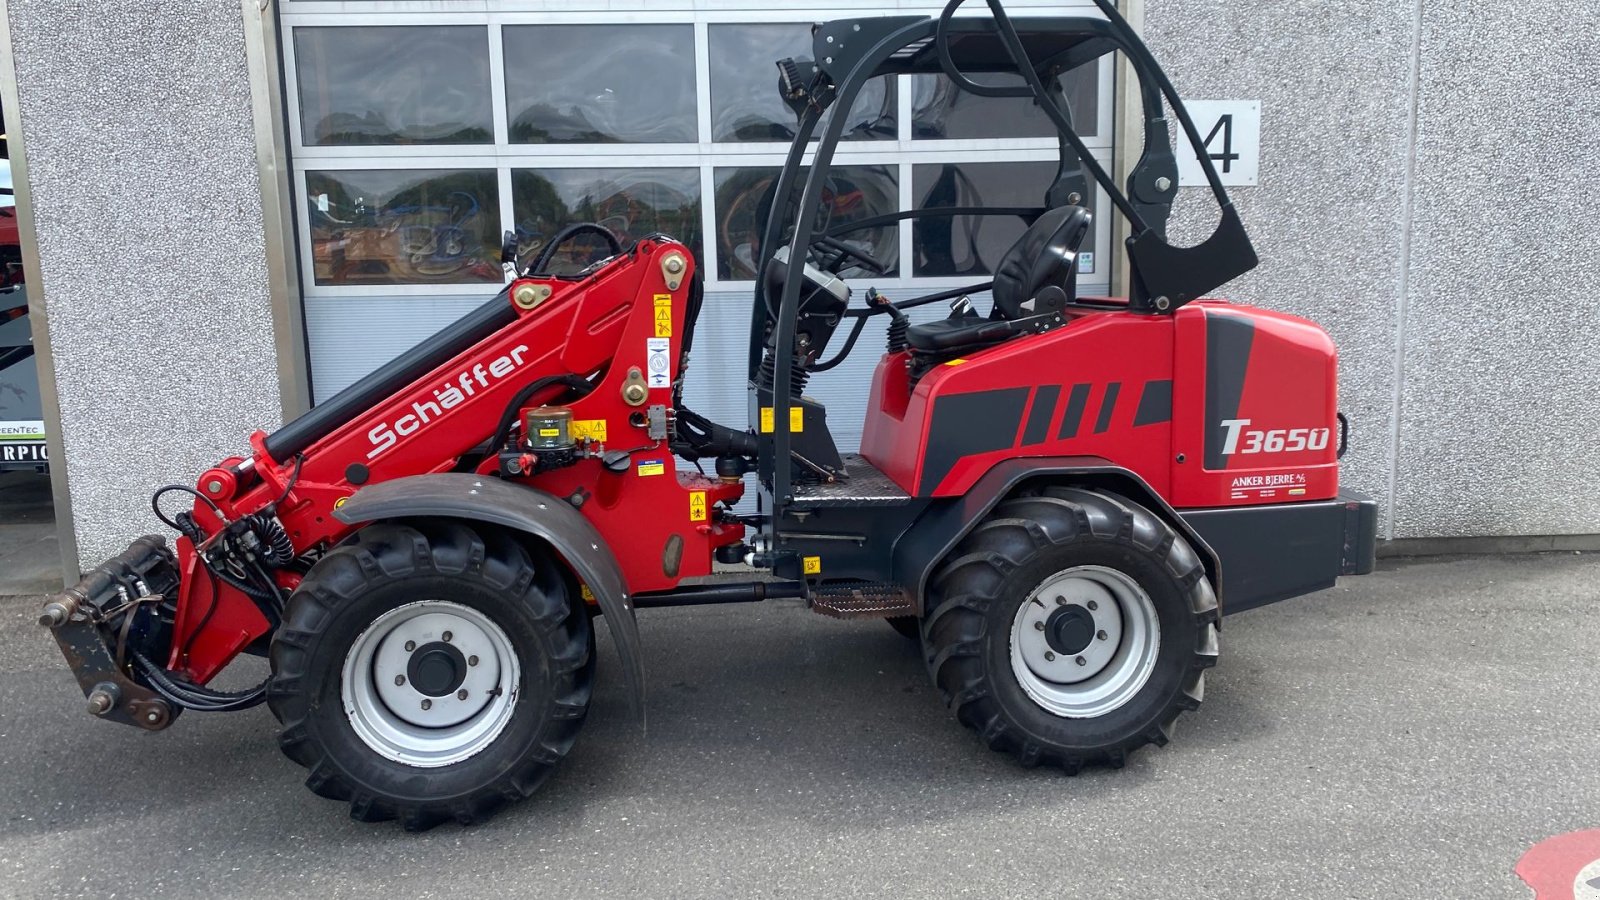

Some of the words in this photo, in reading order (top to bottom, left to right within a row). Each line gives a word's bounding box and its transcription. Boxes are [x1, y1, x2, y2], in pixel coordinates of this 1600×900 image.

[1196, 114, 1239, 173] 4
[366, 344, 529, 459] Schäffer
[1220, 419, 1329, 455] T3650
[1231, 476, 1263, 487] ANKER
[1265, 474, 1295, 485] BJERRE
